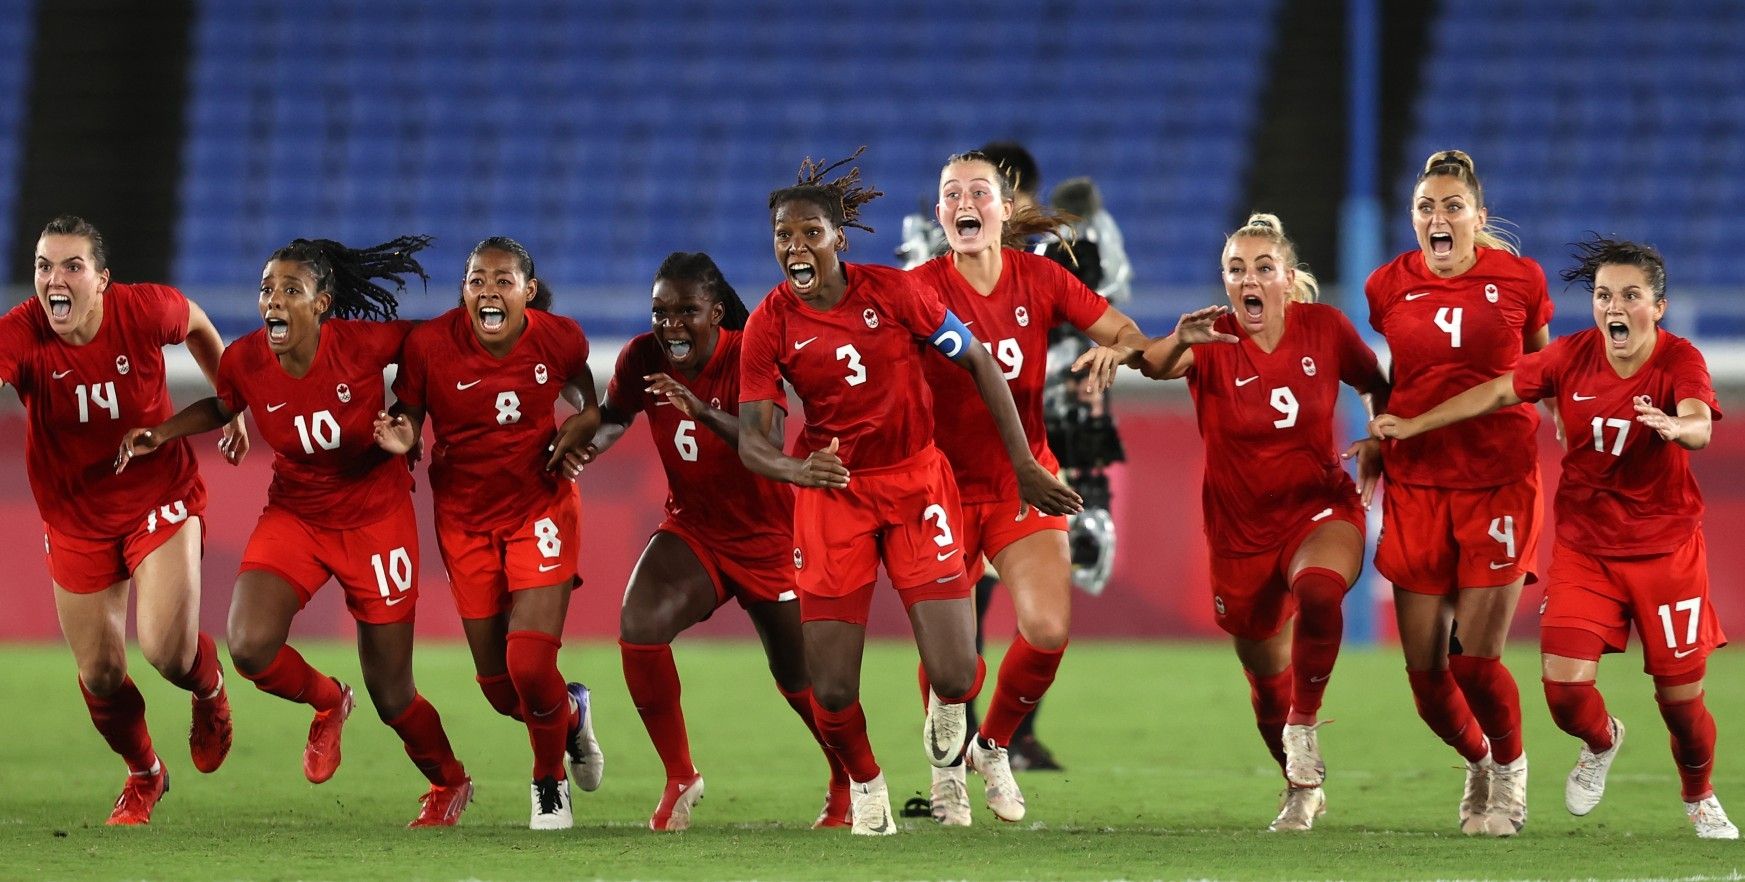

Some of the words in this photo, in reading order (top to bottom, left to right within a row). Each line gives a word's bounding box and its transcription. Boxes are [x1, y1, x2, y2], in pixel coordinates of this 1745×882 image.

[1434, 307, 1463, 348] 4
[836, 344, 867, 387] 3
[982, 338, 1024, 381] 9
[75, 381, 119, 423] 14
[495, 391, 522, 425] 8
[1270, 386, 1300, 429] 9
[294, 410, 341, 454] 10
[674, 419, 698, 462] 6
[1591, 416, 1632, 457] 17
[535, 518, 562, 559] 8
[924, 504, 954, 547] 3
[1488, 515, 1516, 558] 4
[372, 547, 412, 598] 10
[1658, 597, 1702, 649] 17
